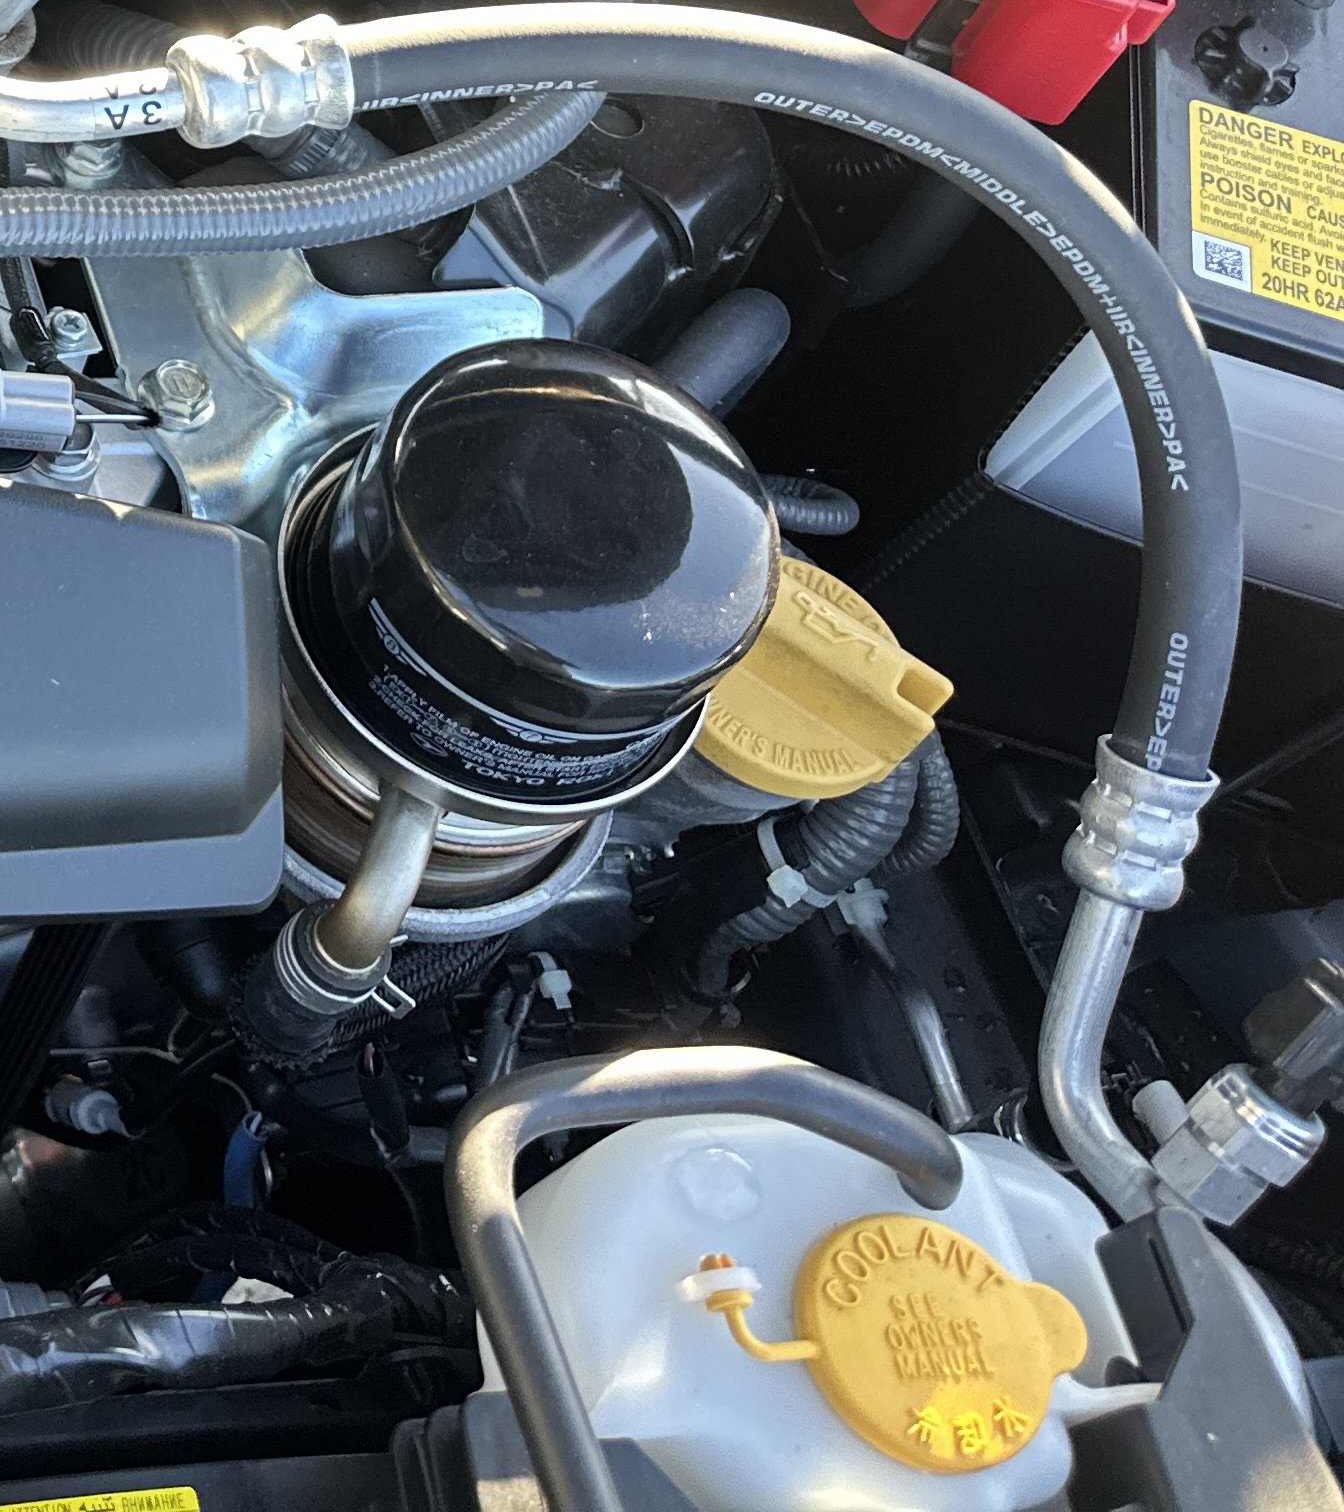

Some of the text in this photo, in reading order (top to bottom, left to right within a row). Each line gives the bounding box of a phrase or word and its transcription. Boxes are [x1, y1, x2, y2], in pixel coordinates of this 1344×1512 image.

[1199, 107, 1294, 150] DANGER
[1200, 136, 1237, 155] Always
[1241, 150, 1272, 166] shield
[1275, 160, 1299, 174] eyes
[1303, 169, 1323, 181] and
[1200, 150, 1219, 162] use
[1223, 154, 1262, 174] booster
[1302, 181, 1314, 191] or
[1200, 159, 1255, 185] instruction
[1258, 178, 1278, 191] and
[1297, 155, 1309, 165] or
[1200, 188, 1248, 211] Contains
[1251, 206, 1289, 224] sulfuric
[1201, 172, 1292, 214] POISON
[1200, 200, 1210, 212] In
[1213, 206, 1243, 223] event
[1246, 216, 1258, 226] of
[1260, 221, 1305, 241] accident
[1271, 238, 1311, 261] KEEP
[1271, 254, 1312, 278] KEEP
[1261, 271, 1311, 303] 20HR
[428, 705, 458, 728] FILM
[460, 726, 480, 738] OF
[461, 758, 545, 786] TOKYO
[772, 744, 861, 776] MANUAL
[823, 1224, 1006, 1308] COOLANT
[889, 1292, 942, 1320] SEE
[884, 1317, 984, 1351] OWNERS
[892, 1345, 996, 1380] MANUAL
